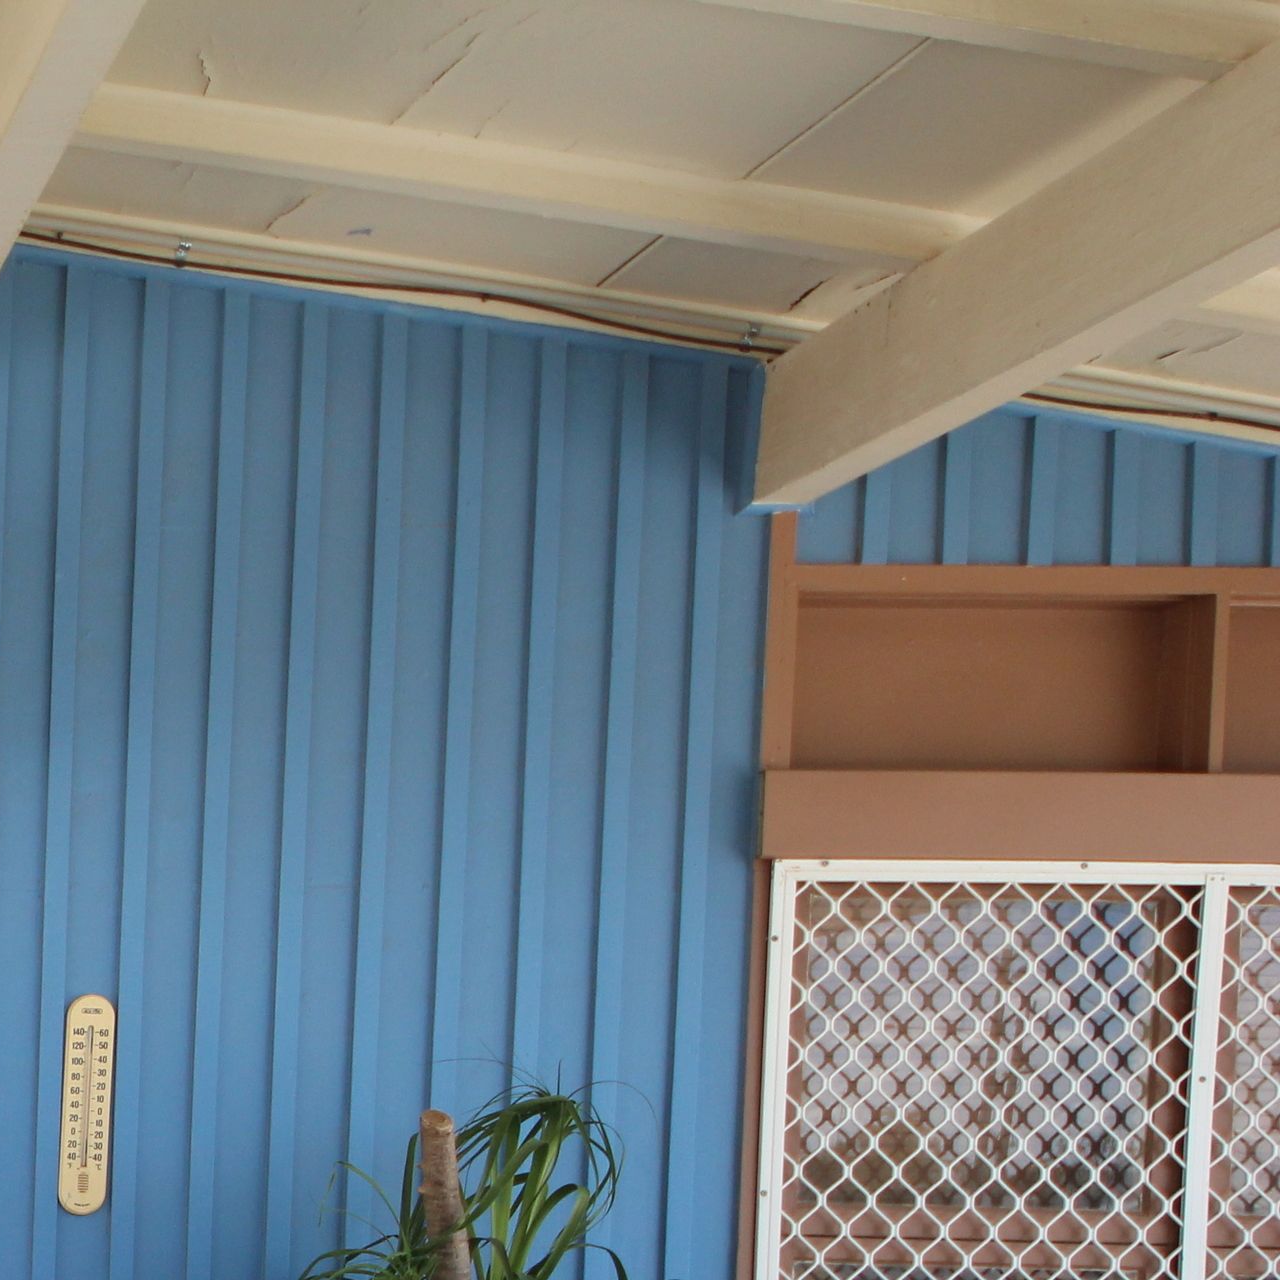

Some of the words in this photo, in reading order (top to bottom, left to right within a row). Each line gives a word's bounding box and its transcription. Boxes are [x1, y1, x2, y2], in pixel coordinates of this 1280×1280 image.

[73, 1028, 85, 1036] 140
[99, 1028, 109, 1037] 60
[72, 1042, 84, 1050] 120
[98, 1041, 108, 1049] 50
[71, 1057, 83, 1065] 100
[97, 1055, 107, 1063] 40
[71, 1072, 80, 1080] 80
[97, 1069, 106, 1077] 30
[96, 1082, 105, 1090] 20
[70, 1087, 80, 1095] 60
[96, 1095, 104, 1103] 10
[97, 1107, 102, 1115] 0
[69, 1114, 79, 1122] 20
[95, 1119, 103, 1127] 10
[71, 1127, 76, 1135] 0
[94, 1131, 103, 1139] 20
[67, 1140, 77, 1148] 20
[93, 1142, 103, 1150] 30
[67, 1152, 76, 1160] 40
[93, 1153, 102, 1161] 40
